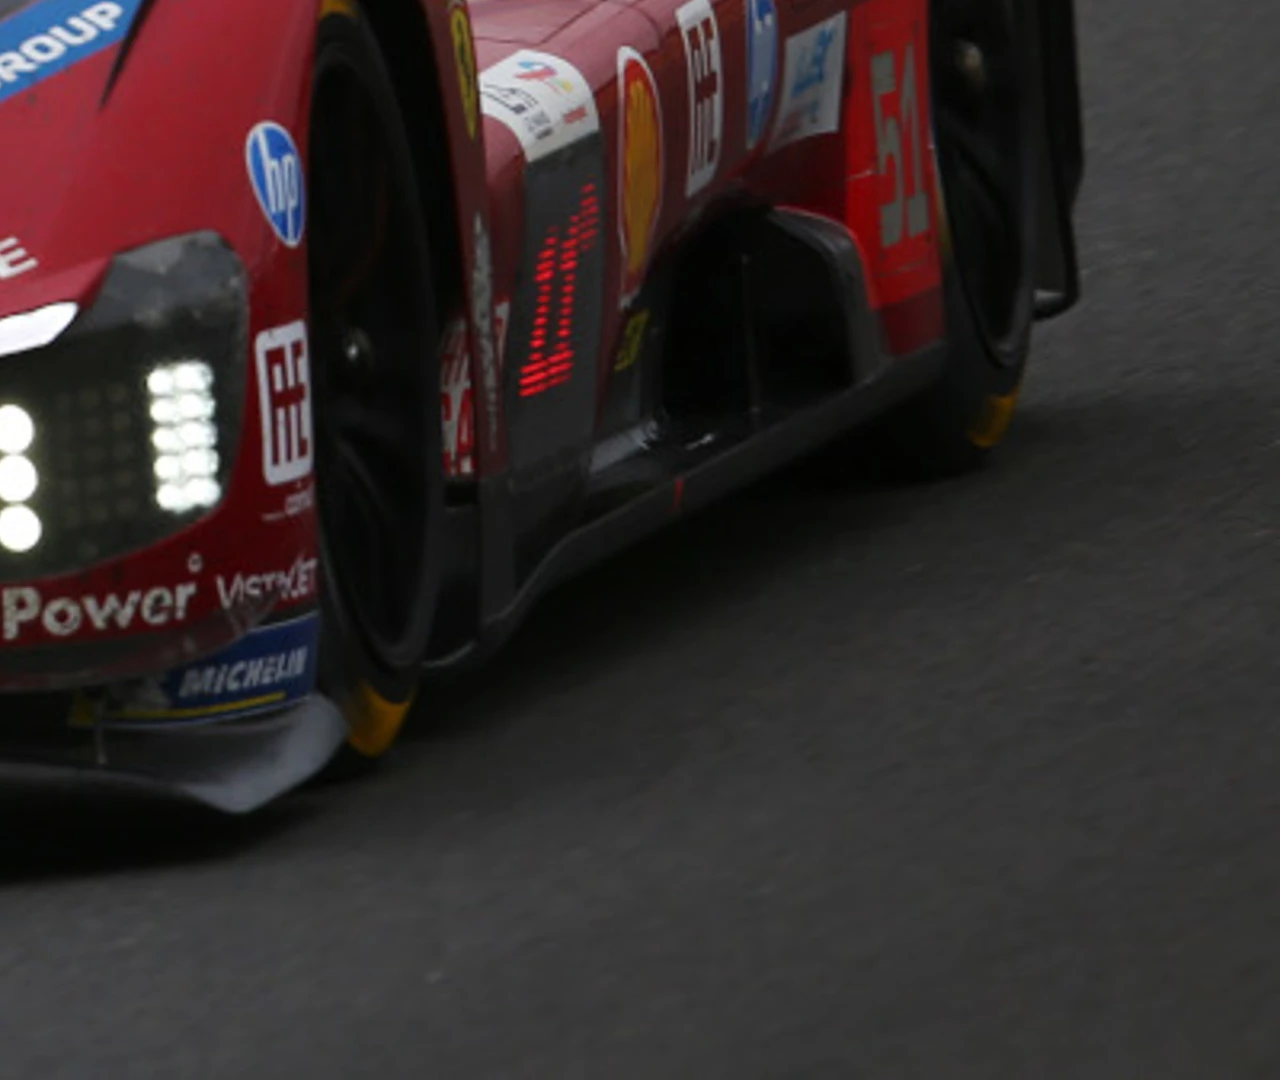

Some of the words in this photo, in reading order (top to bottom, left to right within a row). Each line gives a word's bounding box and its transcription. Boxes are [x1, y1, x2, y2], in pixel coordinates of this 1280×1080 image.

[253, 126, 300, 245] hp
[870, 40, 929, 249] 51
[178, 646, 308, 699] MICHELIN
